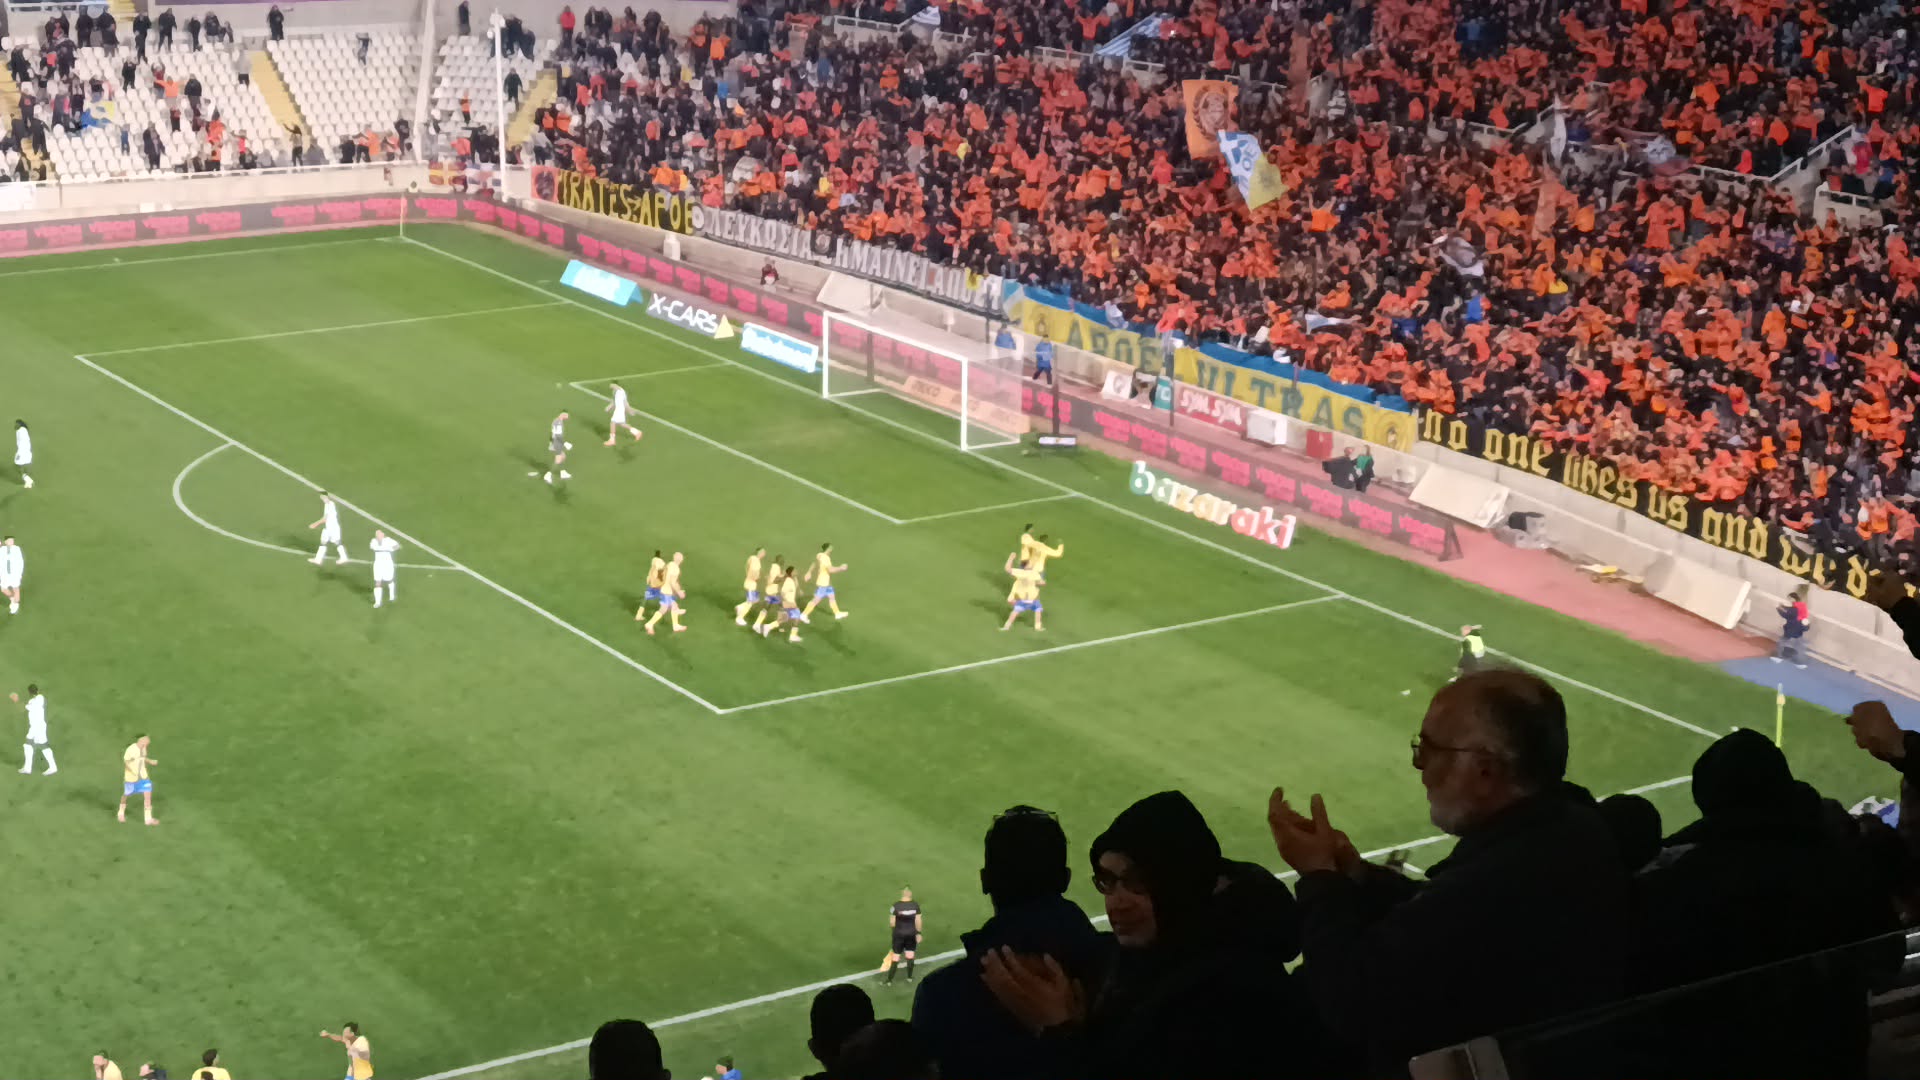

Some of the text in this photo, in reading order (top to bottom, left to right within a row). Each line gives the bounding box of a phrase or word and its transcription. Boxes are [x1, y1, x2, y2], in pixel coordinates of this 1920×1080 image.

[557, 170, 632, 222] IRATES
[640, 190, 696, 236] APOE
[815, 237, 930, 291] ΗΜΑΙΝΕΙ
[648, 293, 718, 333] X-CARS
[1129, 460, 1297, 549] bazaraki
[1423, 408, 1468, 450] no
[1482, 427, 1551, 475] one
[1563, 453, 1638, 509] likes
[1647, 483, 1689, 531] us
[1701, 508, 1769, 560] and
